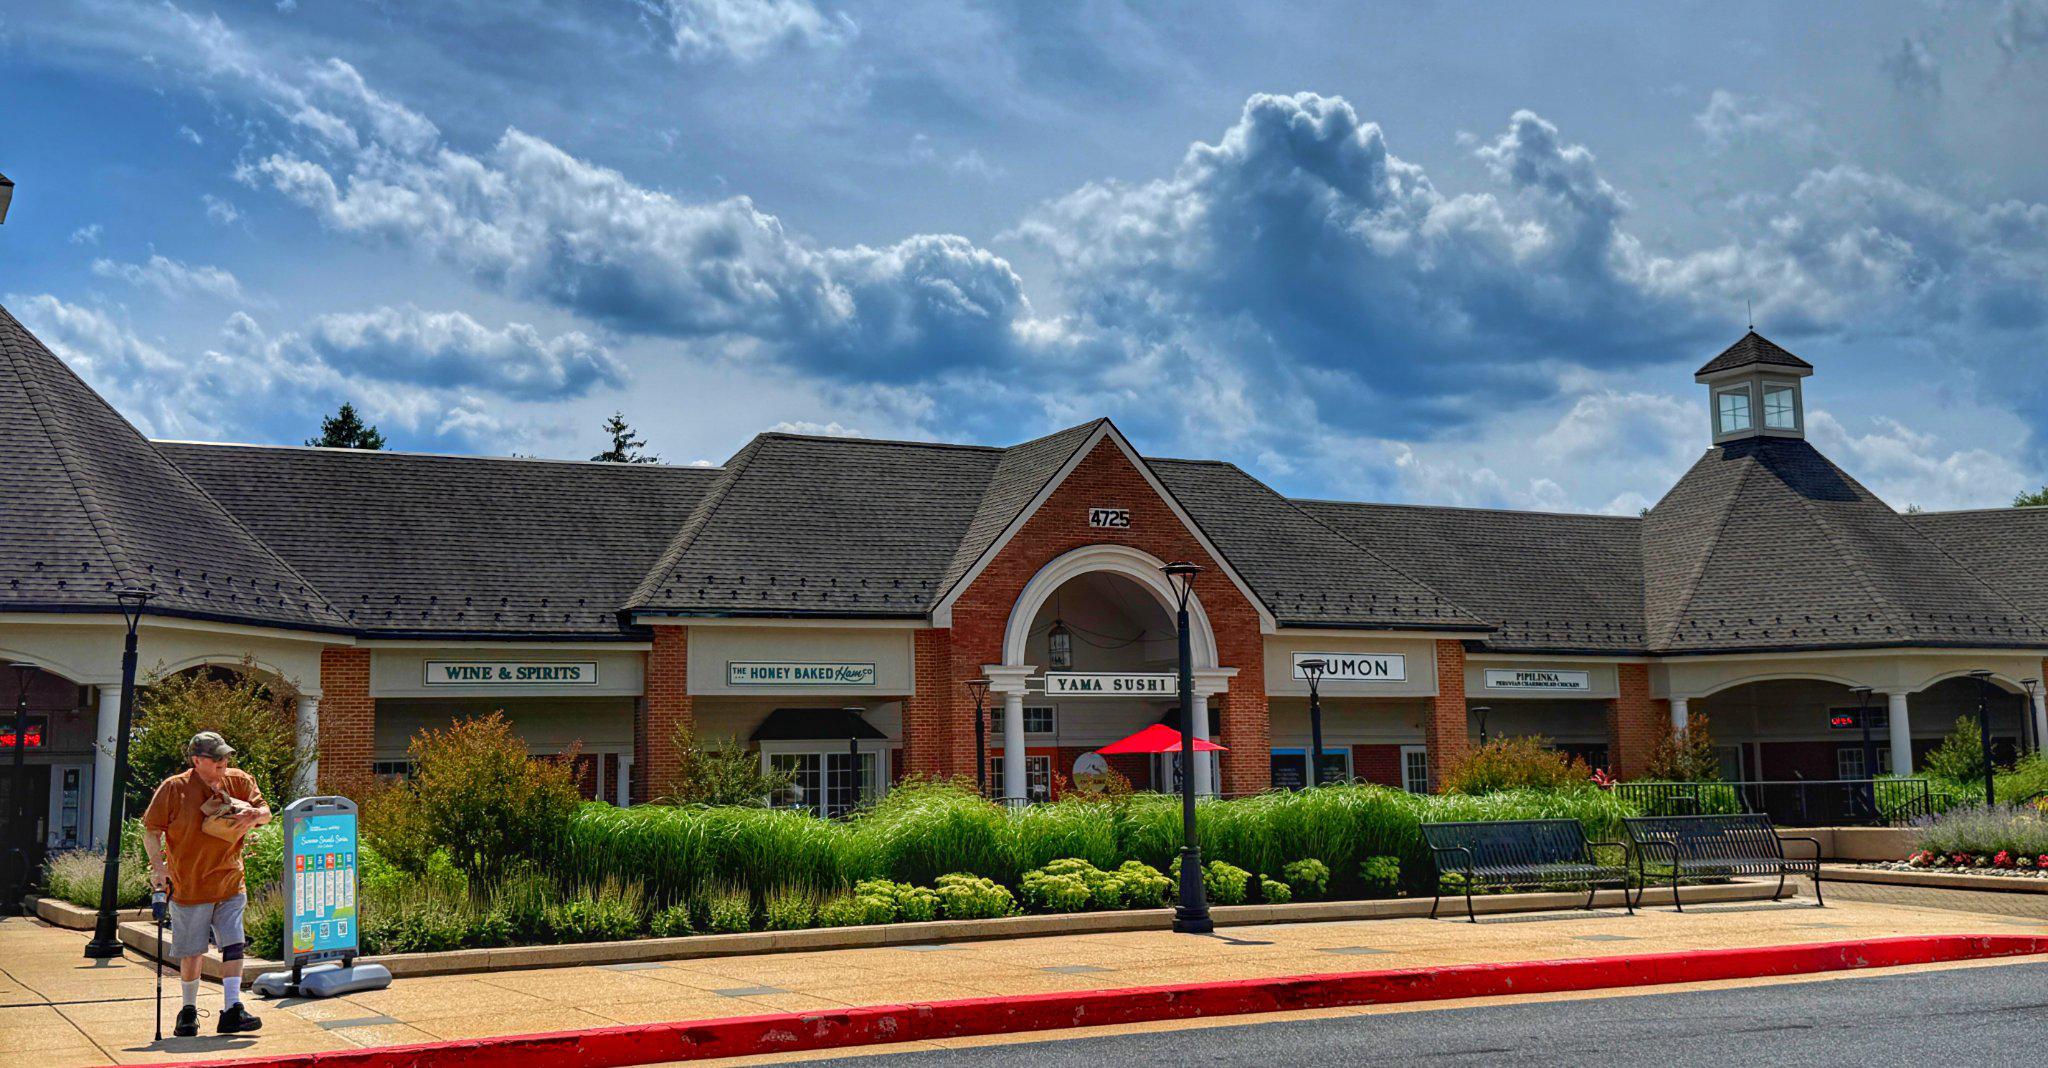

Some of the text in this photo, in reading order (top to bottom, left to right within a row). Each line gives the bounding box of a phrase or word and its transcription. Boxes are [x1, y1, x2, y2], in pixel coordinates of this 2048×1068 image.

[1091, 510, 1130, 527] 4725
[445, 666, 581, 680] WINE & SPIRITS
[732, 667, 747, 675] THE
[750, 667, 791, 680] HONEY
[794, 667, 834, 680] BAKED
[834, 666, 864, 682] Ham
[1314, 659, 1388, 676] UMON
[1057, 678, 1166, 691] YAMA SUSHI
[1516, 672, 1559, 682] PIPILINKA
